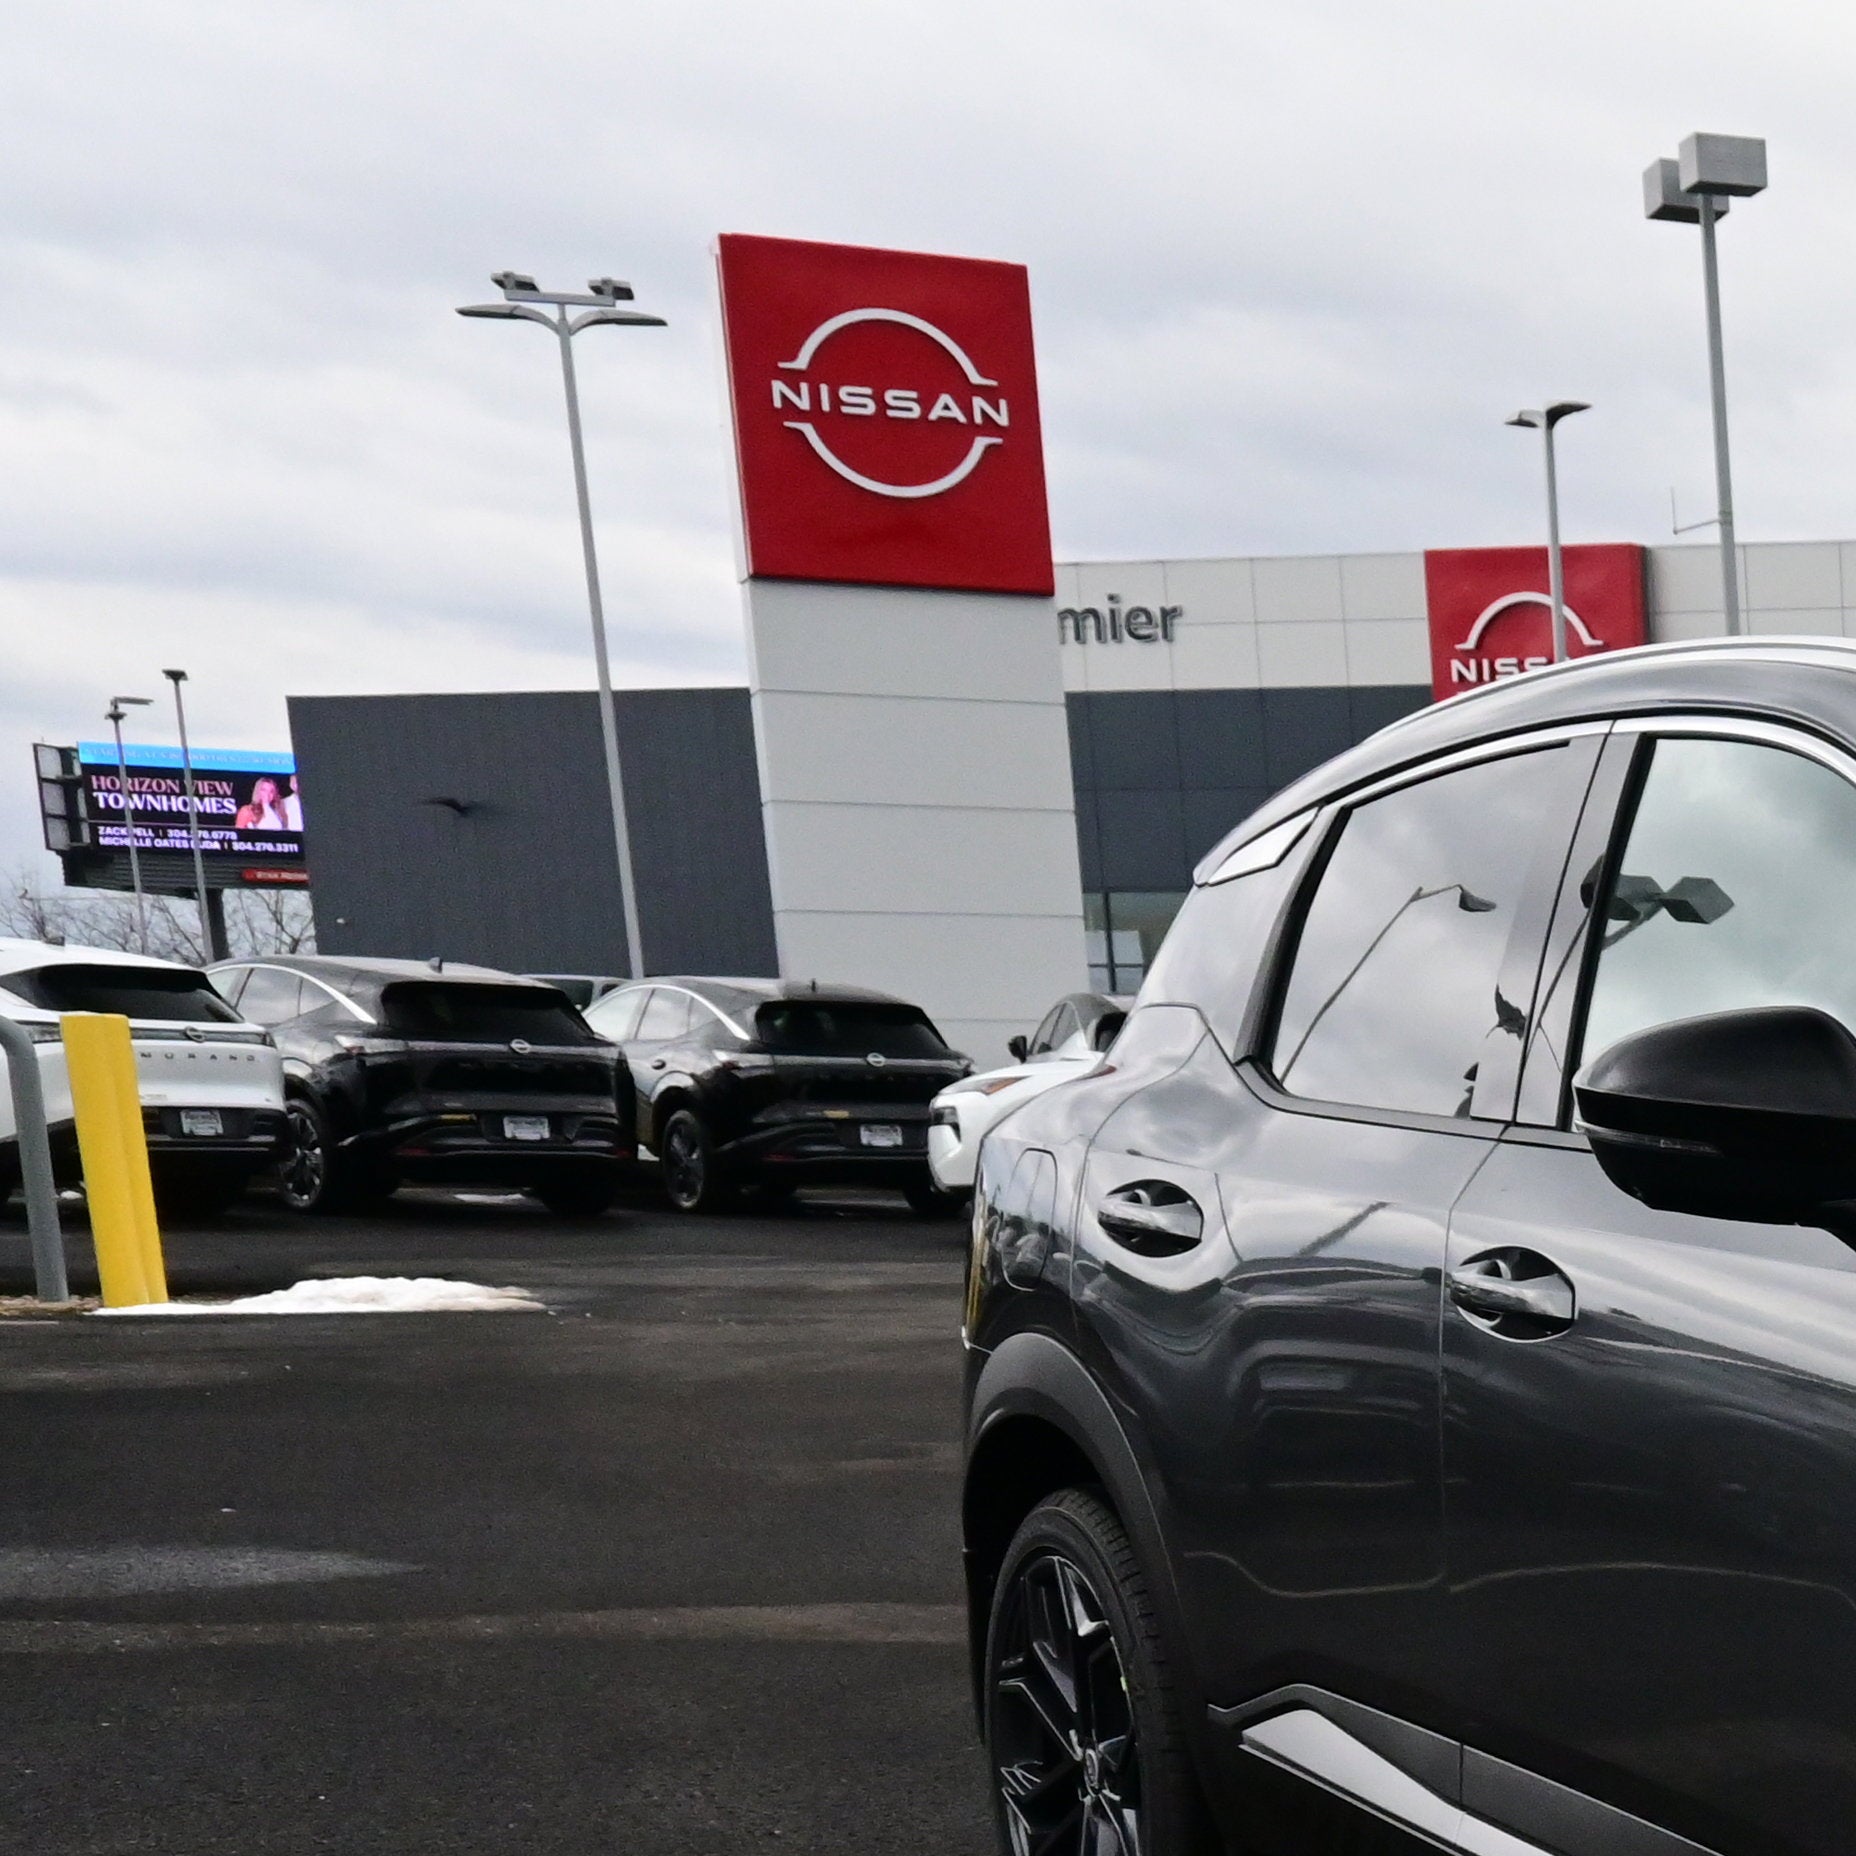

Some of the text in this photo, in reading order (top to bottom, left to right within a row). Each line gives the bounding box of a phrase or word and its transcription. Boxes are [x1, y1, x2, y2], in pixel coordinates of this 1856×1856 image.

[771, 378, 1011, 428] NISSAN
[91, 775, 180, 794] HORIZON
[92, 791, 237, 815] TOWNHOMES
[98, 836, 153, 848] MICHLLE
[140, 1051, 256, 1062] MURANO
